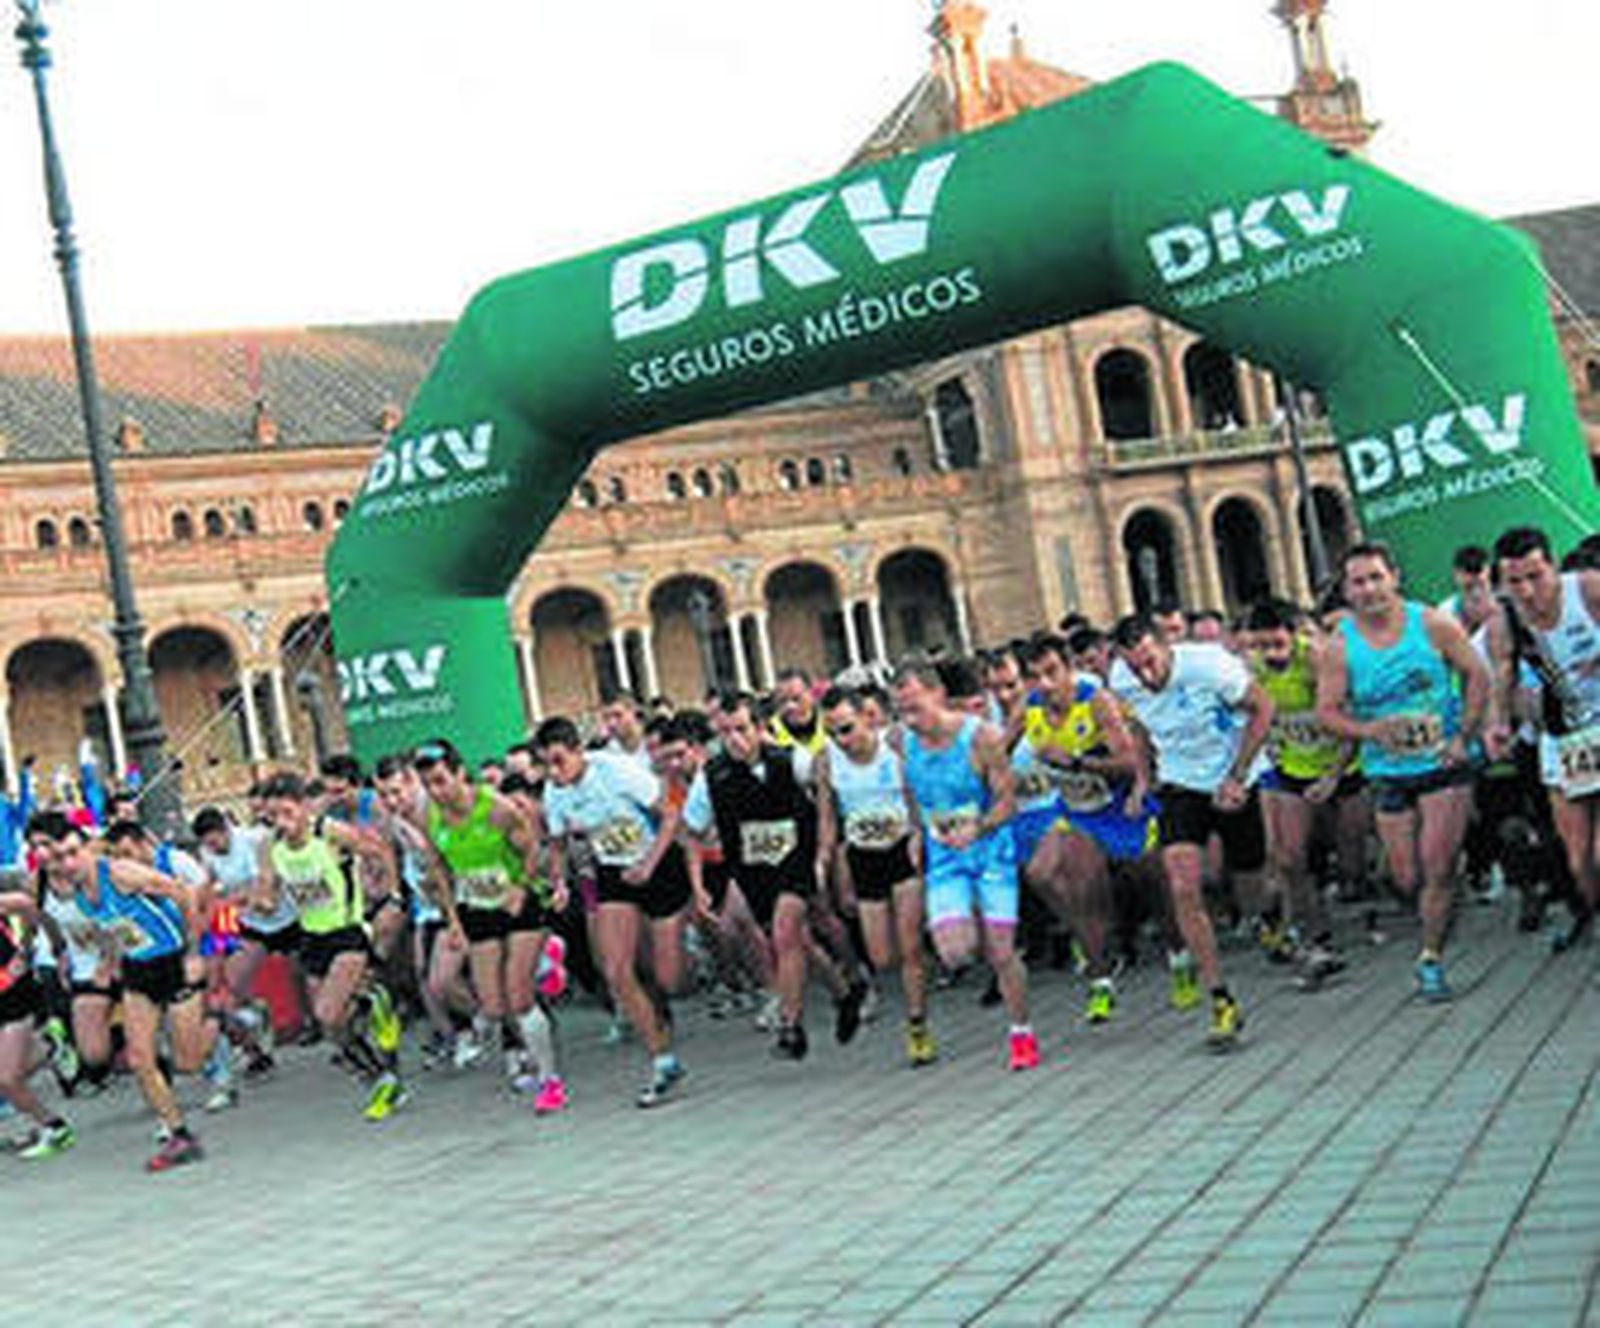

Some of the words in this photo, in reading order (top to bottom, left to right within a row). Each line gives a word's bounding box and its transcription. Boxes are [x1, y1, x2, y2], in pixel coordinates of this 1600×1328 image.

[611, 152, 956, 341] DKV
[1147, 185, 1351, 282] DKV
[628, 322, 796, 394] SEGUROS
[804, 266, 982, 347] MÉDICOS
[365, 421, 494, 496] DKV
[1347, 392, 1526, 493] DKV
